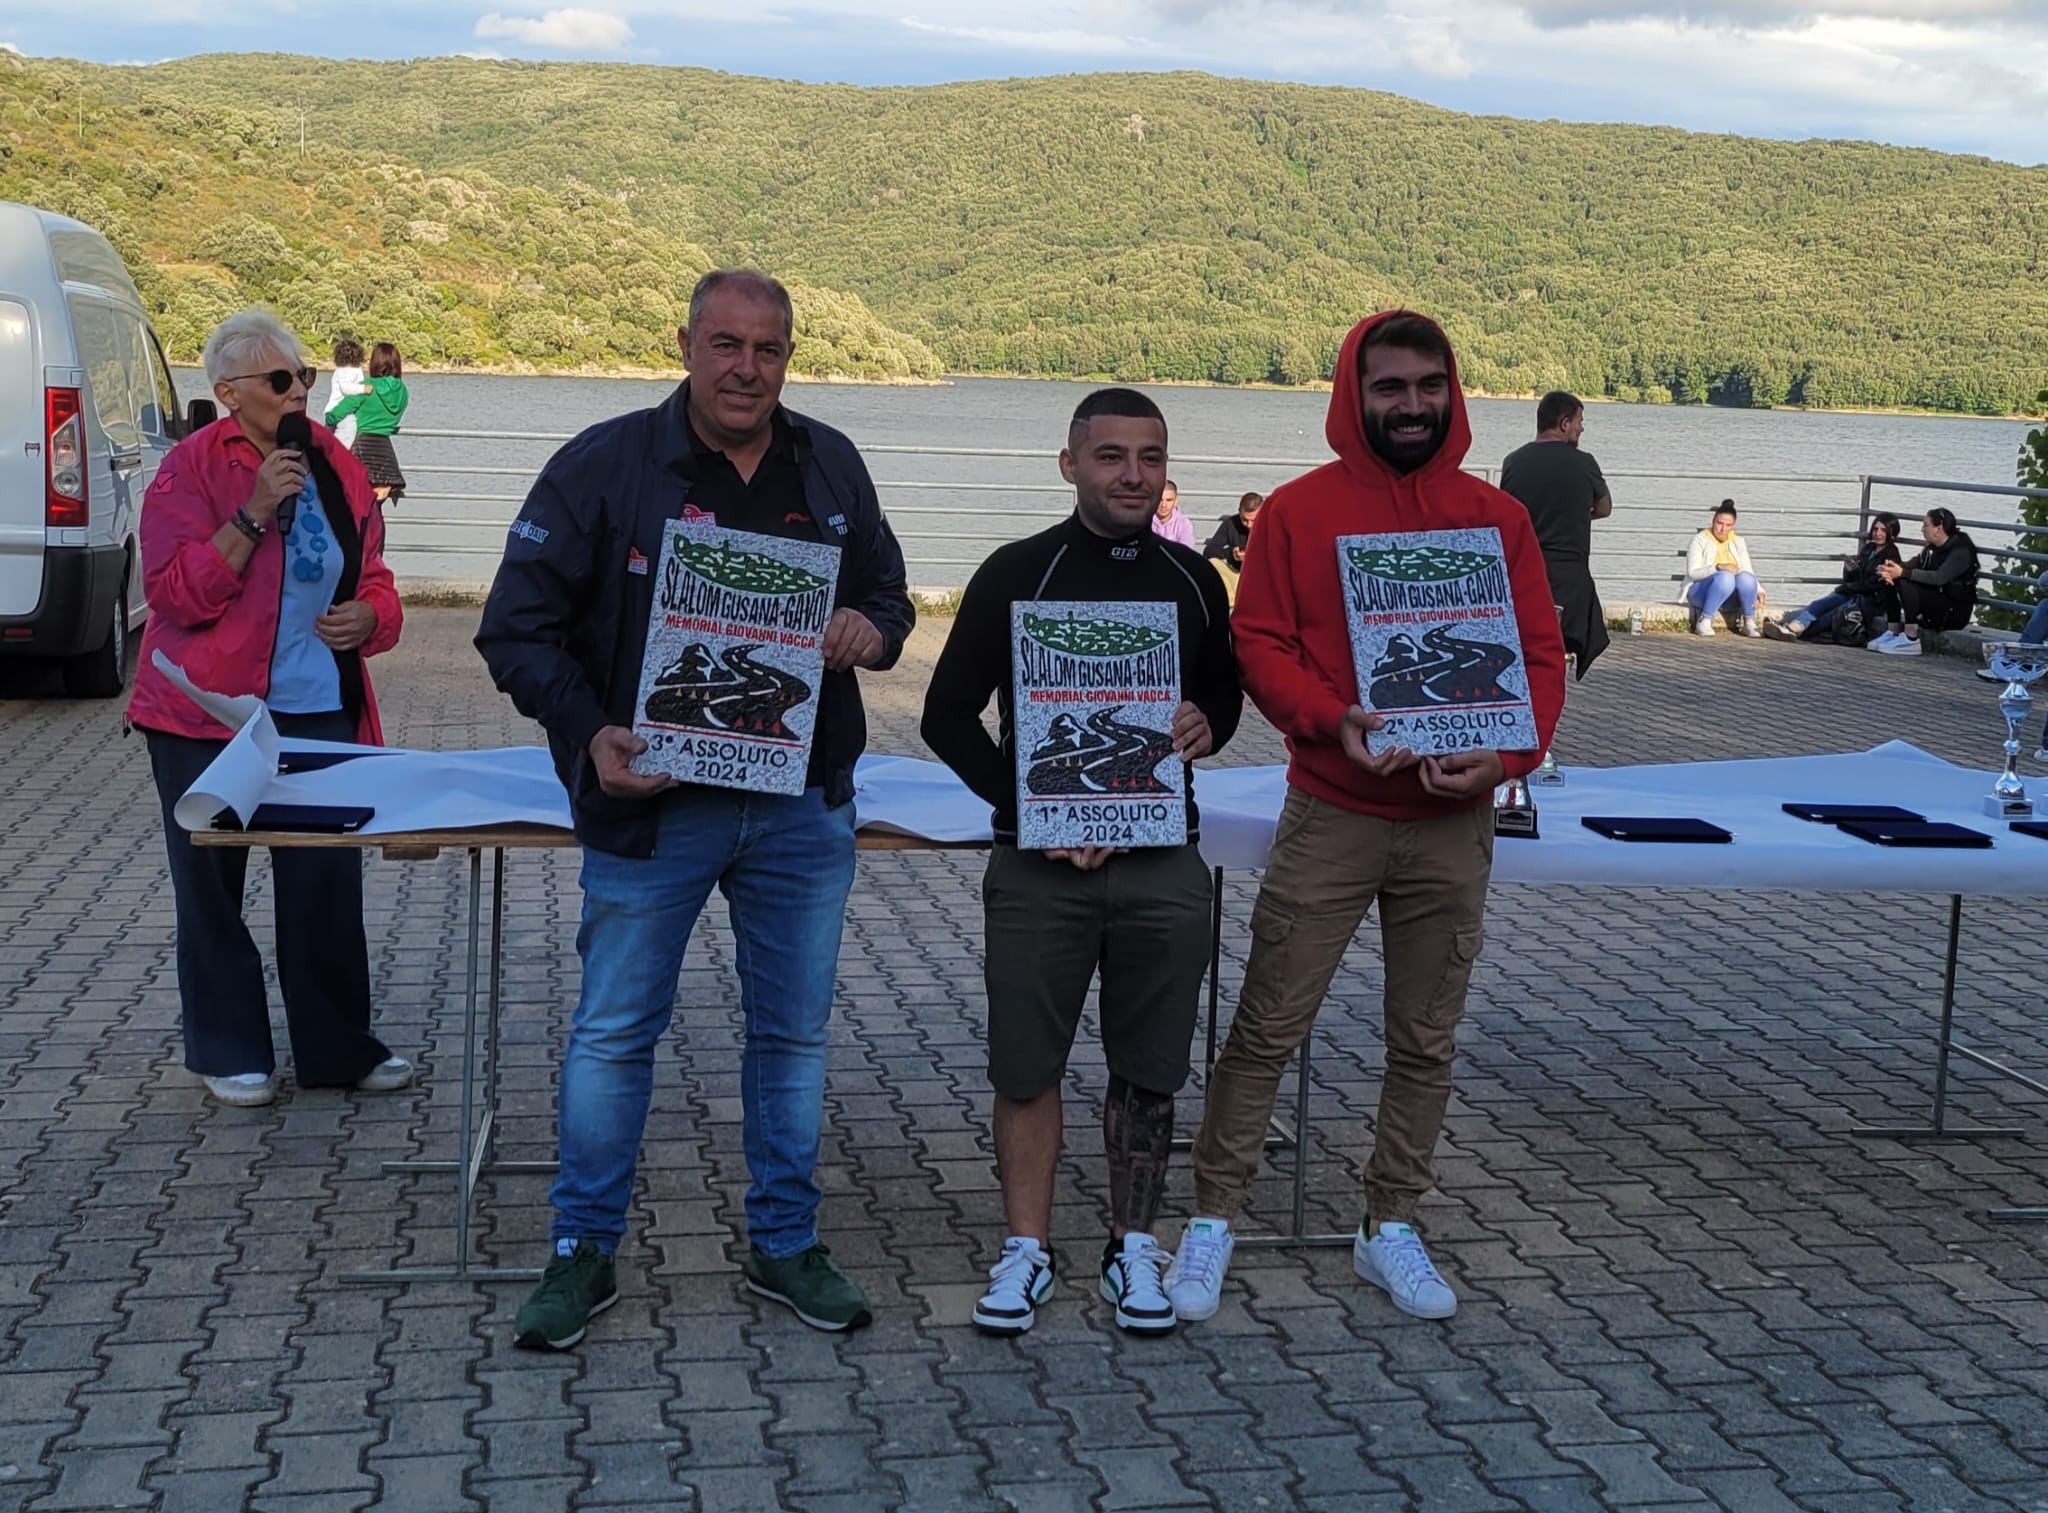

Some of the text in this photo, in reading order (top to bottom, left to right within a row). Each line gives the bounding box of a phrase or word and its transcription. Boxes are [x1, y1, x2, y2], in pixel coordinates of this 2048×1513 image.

[661, 557, 830, 634] SLALOM GUSANA-GAVOI
[1349, 561, 1508, 612] SLALOM GUSANA-GAVOI
[1363, 607, 1505, 626] MEMORIAL GIOVANNI VACCA
[665, 615, 816, 649] MEMORIAL GIOVANNI VACCA
[1020, 636, 1176, 688] SLALOM GUSANA-GAVOI
[1030, 690, 1171, 703] MEMORIAL GIOVANNI VACCA
[1413, 712, 1516, 732] ASSOLUTO
[1432, 733, 1484, 749] 2024
[679, 738, 788, 768] ASSOLUTO
[694, 760, 748, 783] 2024
[1066, 804, 1168, 823] ASSOLUTO
[1083, 825, 1134, 842] 2024
